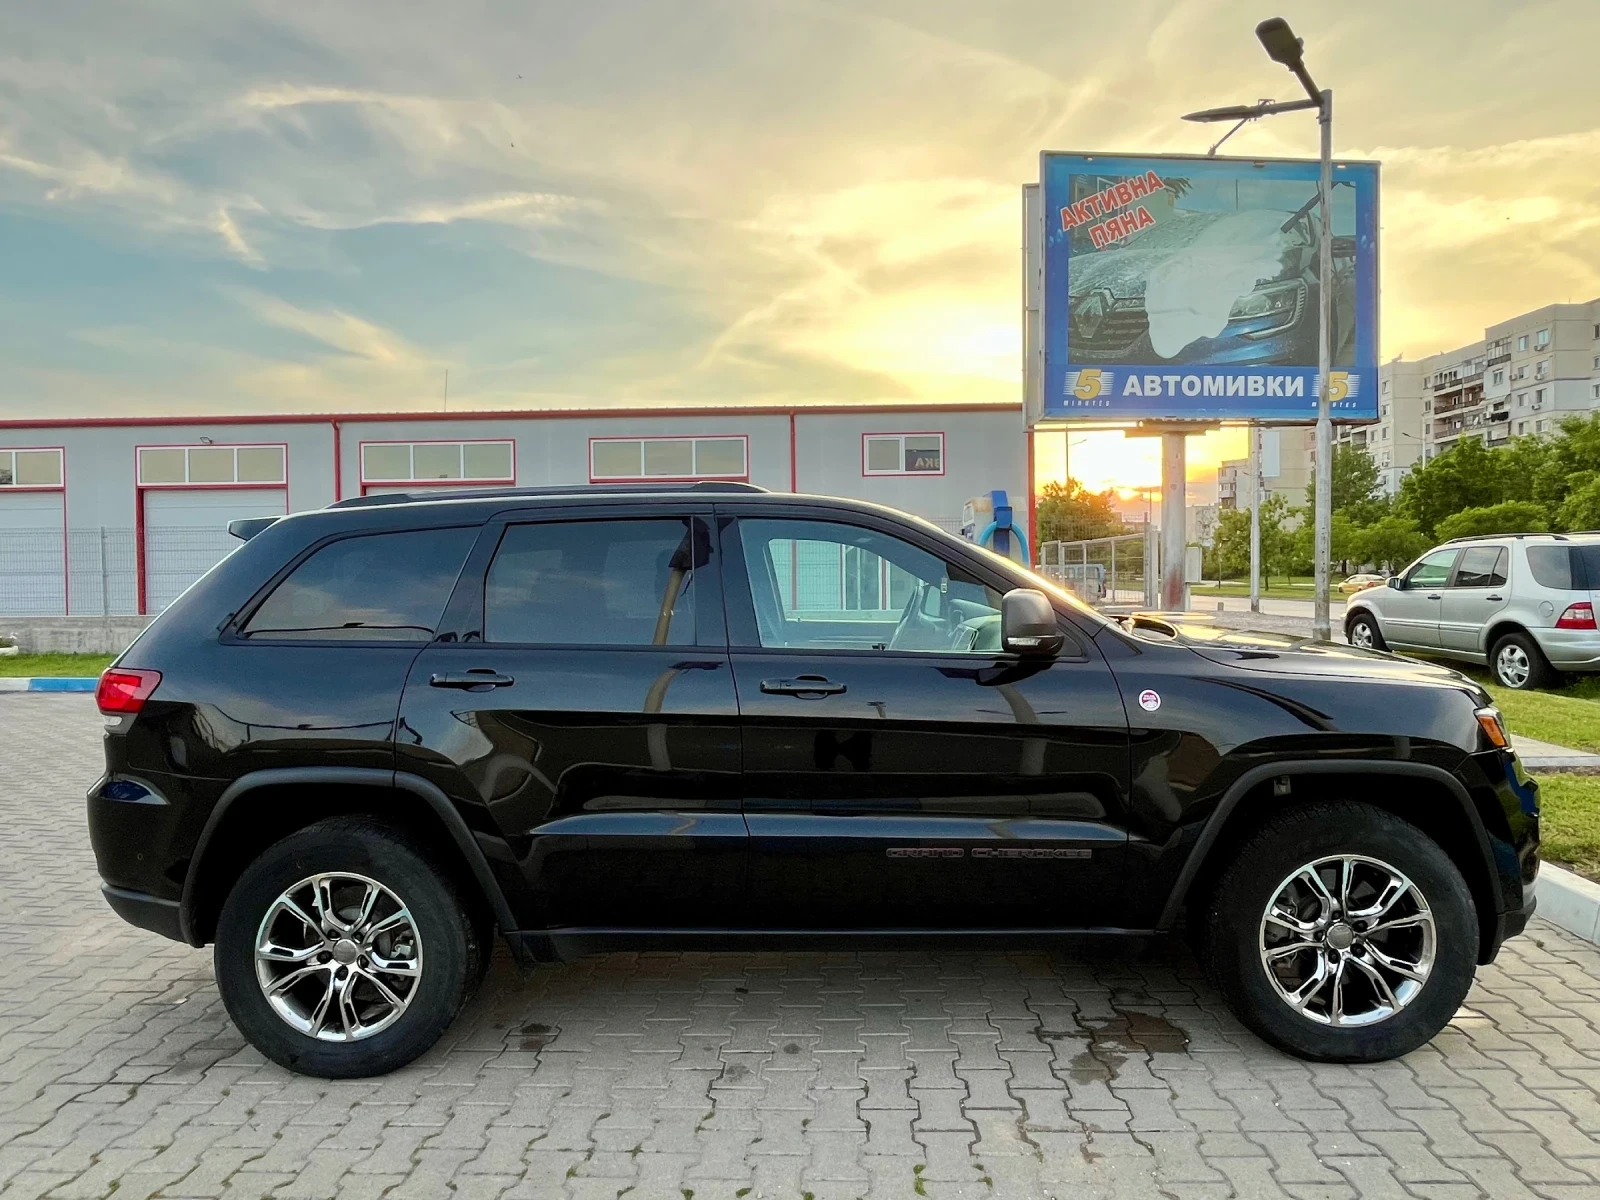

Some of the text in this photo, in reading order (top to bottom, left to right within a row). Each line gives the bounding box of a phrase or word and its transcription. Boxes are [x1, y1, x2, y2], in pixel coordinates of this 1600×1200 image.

[1060, 170, 1165, 231] АКТИВНА
[1088, 206, 1156, 249] ПЯНА
[1073, 368, 1102, 400] 5
[1122, 375, 1304, 397] АВТОМИВКИ
[1328, 371, 1349, 402] 5
[886, 847, 1093, 859] GRAND CHEROKEE
